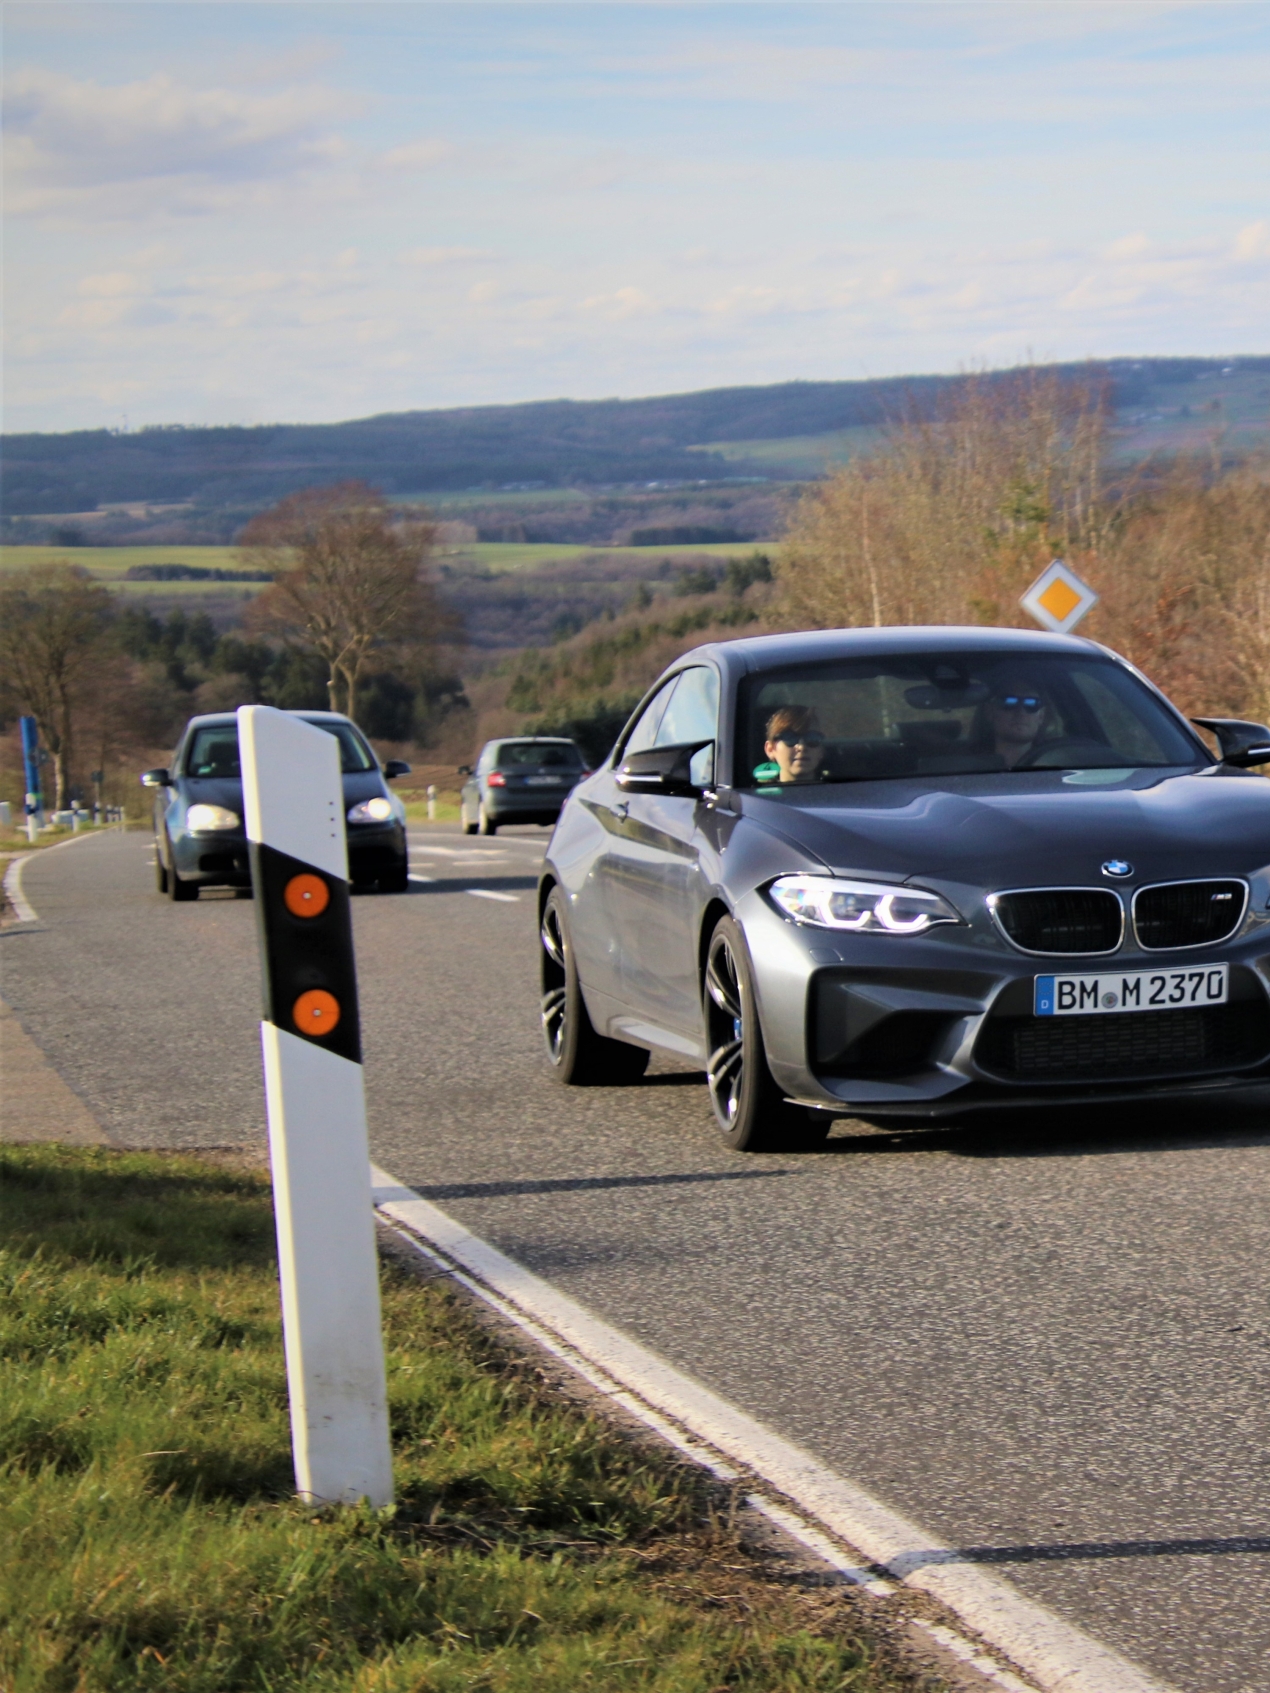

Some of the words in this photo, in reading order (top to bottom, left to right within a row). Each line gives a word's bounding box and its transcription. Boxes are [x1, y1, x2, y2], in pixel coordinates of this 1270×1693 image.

[1057, 980, 1099, 1010] BM
[1121, 977, 1141, 1007] M
[1148, 970, 1223, 1005] 2370
[1041, 1000, 1049, 1009] D
